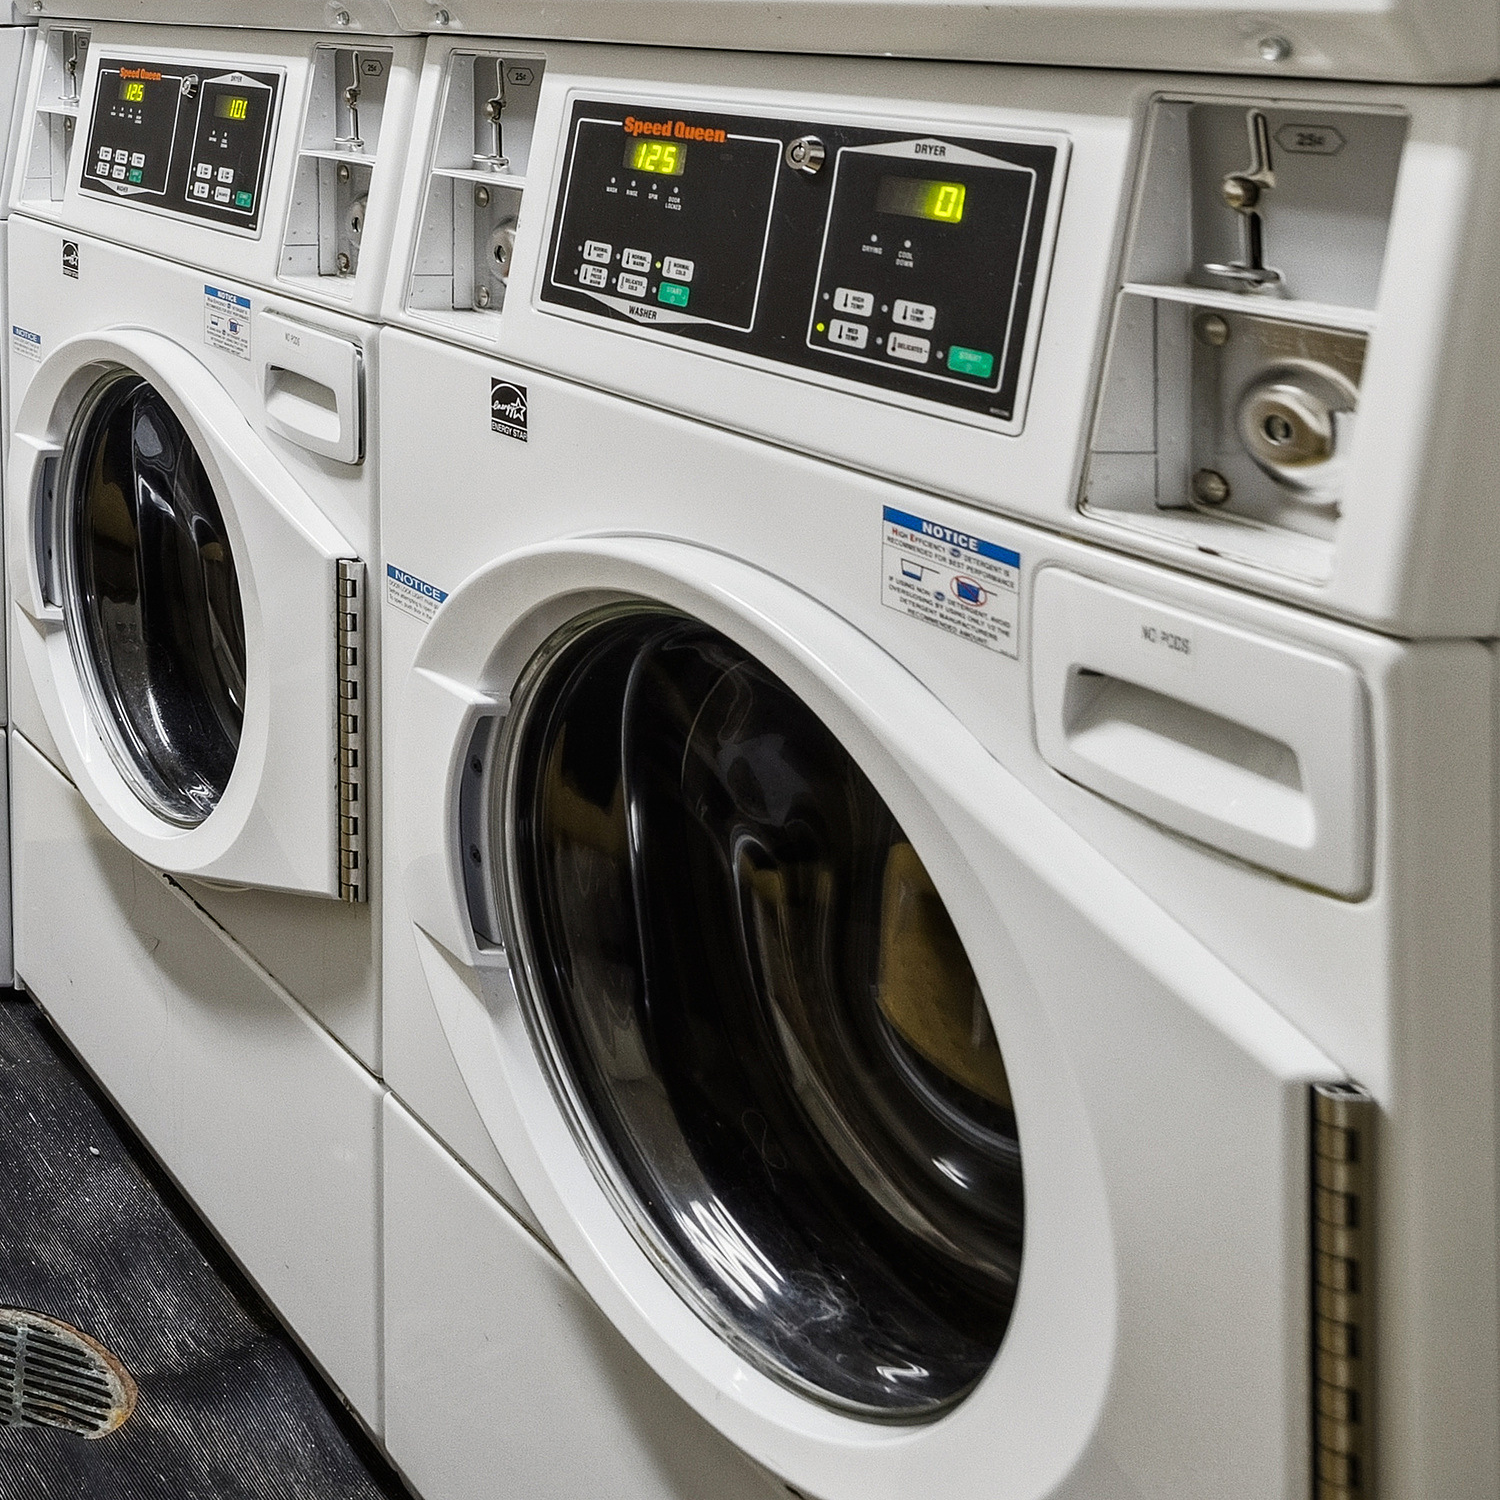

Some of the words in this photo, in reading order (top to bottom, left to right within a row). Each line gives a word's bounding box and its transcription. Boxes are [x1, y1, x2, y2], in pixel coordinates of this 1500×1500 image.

[119, 67, 140, 79] Speed
[140, 69, 162, 81] Queen
[126, 83, 145, 101] 125
[623, 116, 672, 137] Speed
[674, 121, 727, 143] Queen
[636, 143, 677, 173] 125
[914, 143, 947, 157] DRYER
[628, 305, 658, 320] WASHER
[491, 421, 513, 435] ENERGY
[512, 428, 527, 440] STAR
[921, 521, 979, 551] NOTICE
[395, 569, 441, 601] NOTICE
